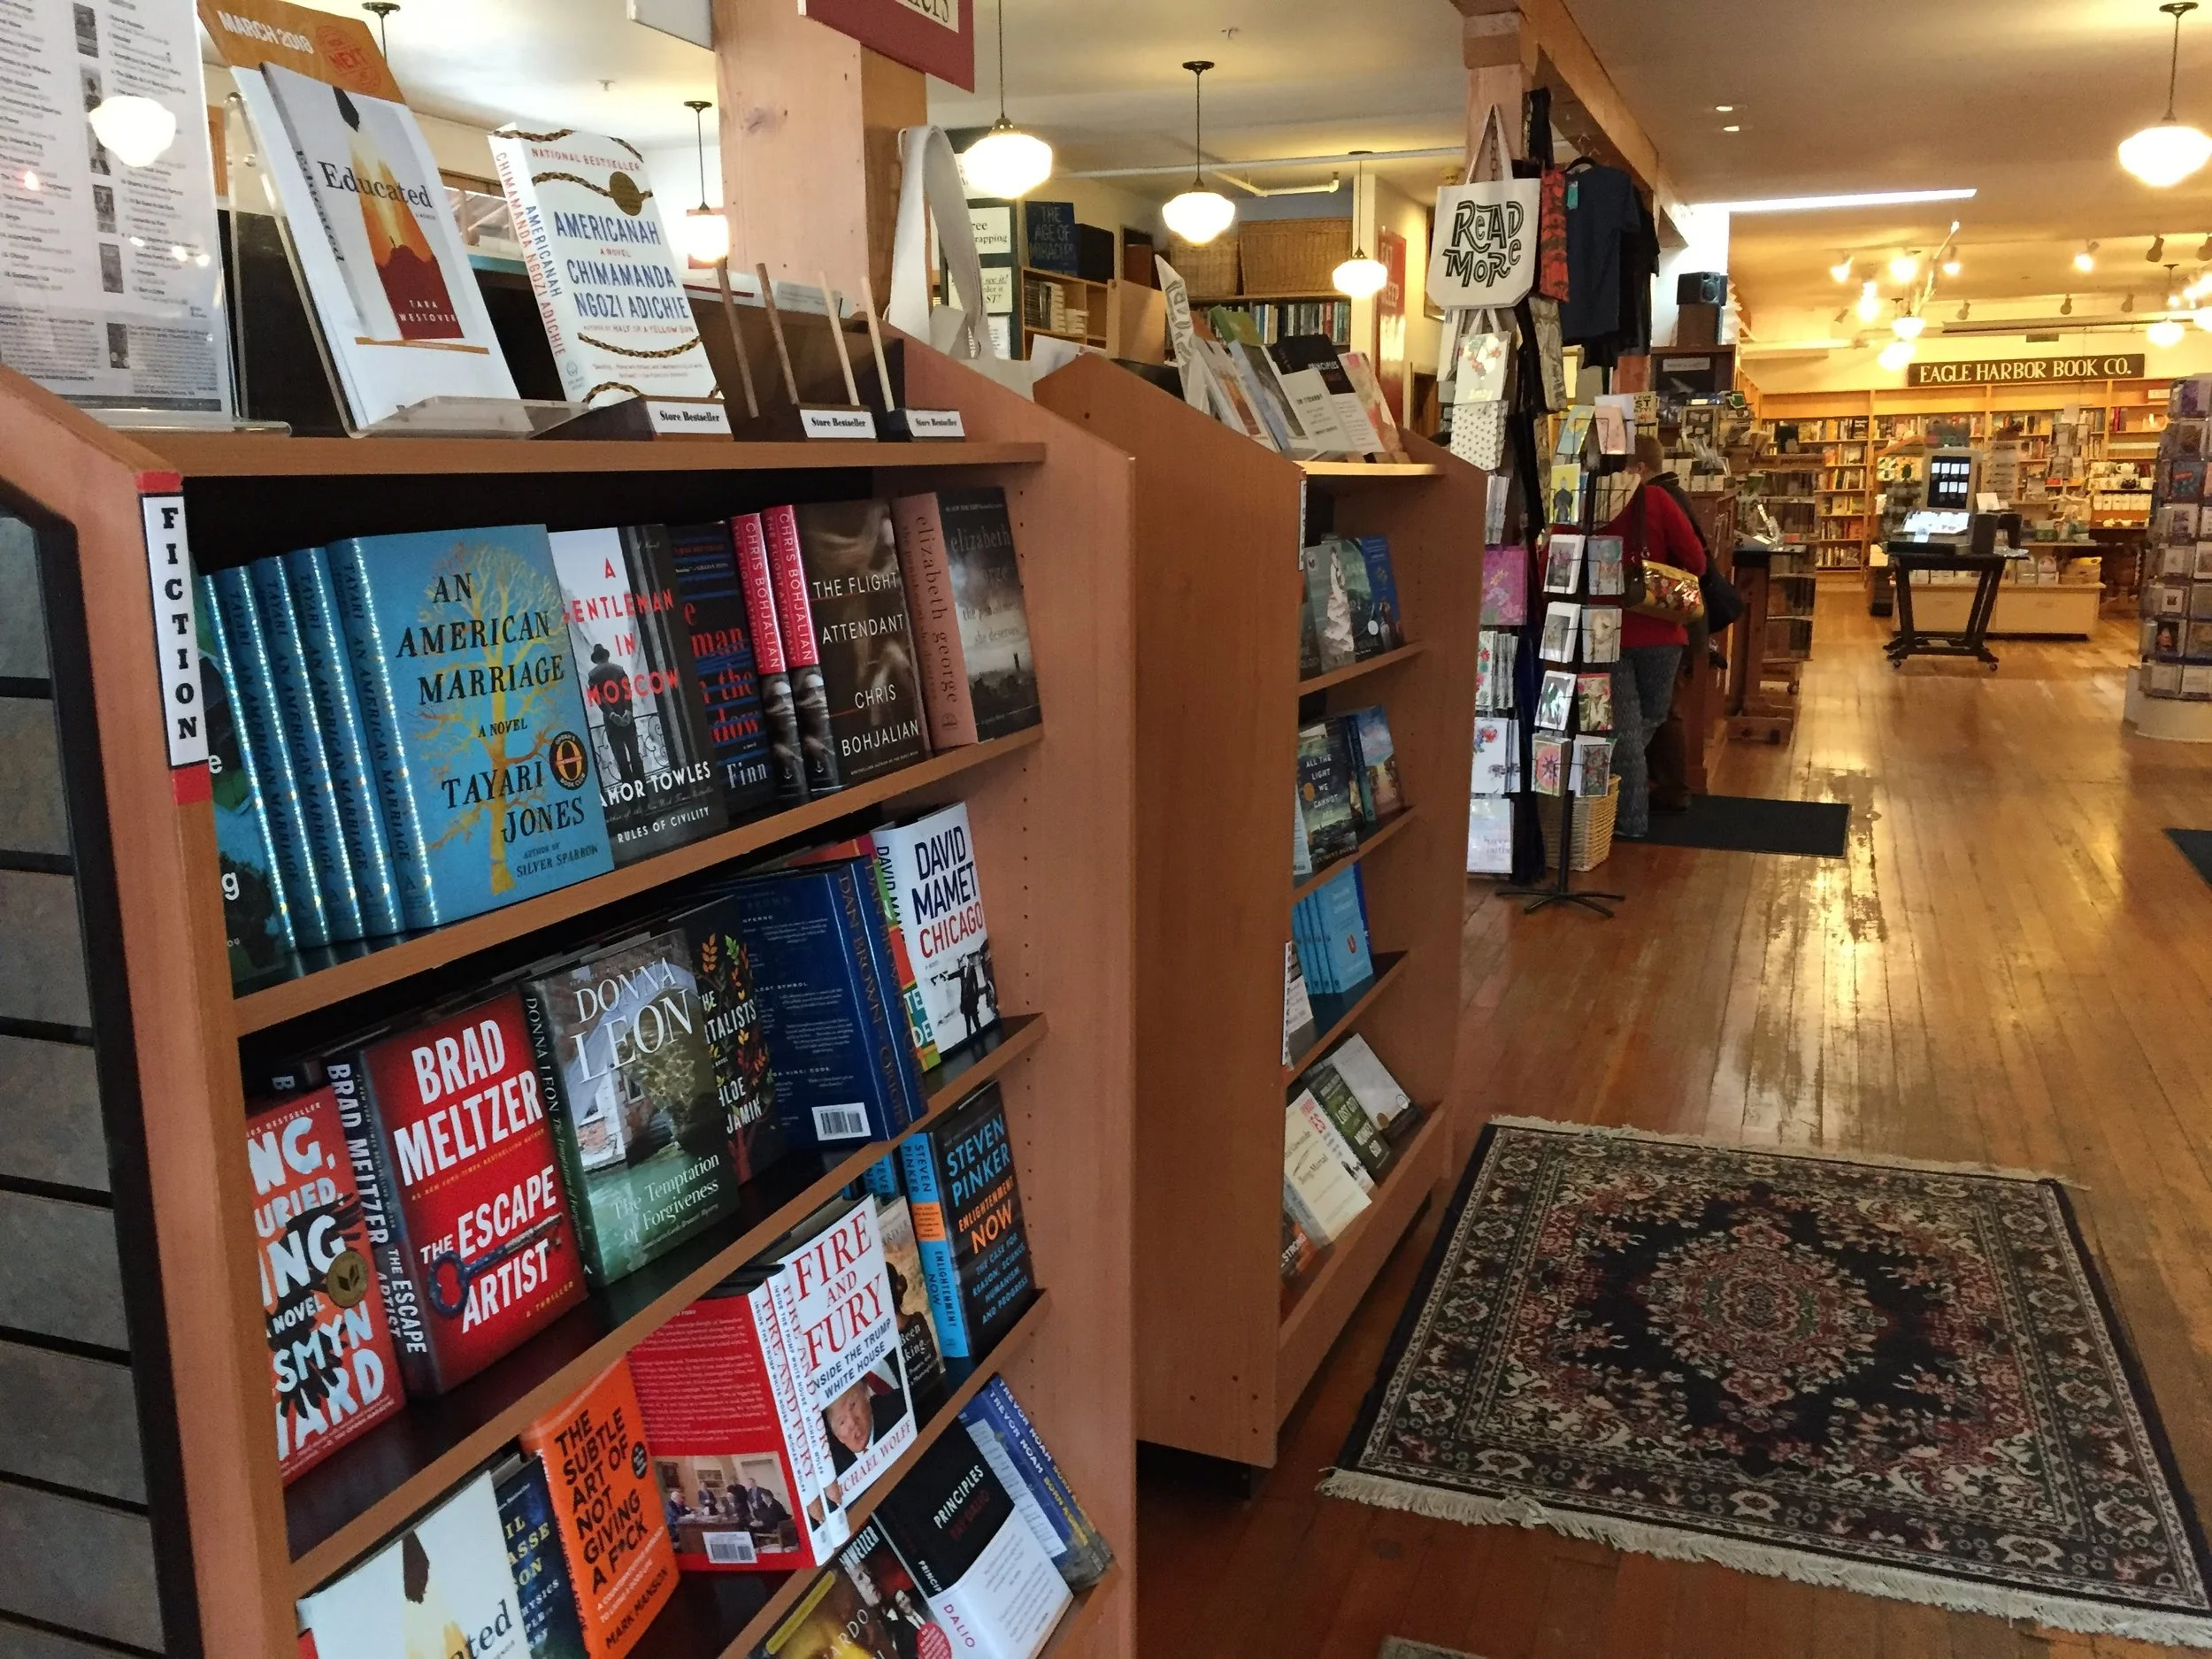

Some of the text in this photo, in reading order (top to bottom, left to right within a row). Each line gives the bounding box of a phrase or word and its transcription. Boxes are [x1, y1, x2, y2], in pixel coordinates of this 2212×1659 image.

[217, 10, 279, 44] MARCH
[317, 160, 433, 208] Educated
[531, 147, 641, 172] NATIONAL BESTSELLER
[526, 204, 564, 298] AMERICANAH
[553, 211, 662, 246] AMERICANAH
[974, 234, 1008, 243] rapping
[496, 152, 566, 356] CHIMAMANDA NGOZI ADICHIE
[565, 258, 678, 288] CHIMAMANDA
[398, 313, 457, 323] WESTOVER
[409, 299, 438, 310] TARA
[574, 292, 691, 320] NGOZI ADICHIE
[1920, 357, 2132, 383] EAGLE HARBOR BOOK CO.
[659, 410, 720, 423] Store Bestseller
[810, 418, 867, 429] Store Bestseller
[915, 419, 958, 428] Store Bestseller
[950, 524, 1011, 553] elizabeth
[432, 572, 474, 603] AN
[604, 557, 617, 580] A
[765, 517, 796, 662] THE FLIGHT ATTENDANT
[780, 513, 814, 660] CHRIS BOHJALIAN
[813, 572, 900, 600] THE FLIGHT
[745, 522, 780, 668] CHRIS BOHJALIAN
[917, 516, 957, 703] elizabeth george
[160, 507, 197, 739] FICTION
[395, 611, 550, 658] AMERICAN
[615, 634, 636, 658] IN
[822, 614, 905, 645] ATTENDANT
[418, 654, 566, 706] MARRIAGE
[586, 666, 680, 708] MOSCOW
[855, 684, 898, 710] CHRIS
[478, 718, 529, 739] A NOVEL
[841, 719, 921, 757] BOHJALIAN
[442, 761, 543, 809] TAYARI
[650, 760, 711, 793] TOWLES
[726, 763, 767, 790] Finn
[1305, 754, 1332, 768] ALL THE
[1311, 768, 1331, 780] LIGHT
[1318, 783, 1329, 792] WE
[382, 768, 411, 862] MARRIAGE
[501, 796, 585, 843] JONES
[618, 806, 710, 843] RULES OF CIVILITY
[517, 844, 598, 878] SILVER SPARROW
[914, 826, 968, 881] DAVID
[911, 861, 978, 926] MAMET
[840, 876, 882, 1024] DAN BROWN
[919, 901, 984, 959] CHICAGO
[574, 957, 678, 1025] DONNA
[526, 997, 561, 1113] DONNA LEON
[571, 988, 695, 1085] LEON
[411, 1018, 507, 1106] BRAD
[393, 1069, 545, 1187] MELTZER
[946, 1114, 1006, 1178] STEVEN
[327, 1063, 362, 1129] BRAD
[347, 1138, 390, 1245] MELTZER
[904, 1146, 920, 1194] PINKER
[915, 1144, 933, 1193] STEVEN
[950, 1142, 1010, 1209] PINKER
[457, 1164, 557, 1259] ESCAPE
[611, 1154, 720, 1221] The Temptation
[624, 1225, 641, 1243] of
[642, 1179, 719, 1232] Forgiveness
[958, 1175, 1015, 1233] ENLIGHTENMENT
[419, 1233, 454, 1265] THE
[971, 1199, 1014, 1254] NOW
[792, 1210, 876, 1302] FIRE
[976, 1245, 1006, 1276] THE CASE
[387, 1248, 428, 1354] THE ESCAPE
[462, 1238, 549, 1334] ARTIST
[535, 1280, 575, 1311] THRILLER
[826, 1271, 857, 1310] AND
[928, 1274, 941, 1306] NOW
[934, 1250, 957, 1328] ENLIGHTENMENT
[981, 1277, 1030, 1325] AND PROGRESS
[273, 1293, 326, 1336] NOVEL
[803, 1274, 883, 1371] FURY
[754, 1302, 764, 1329] INSIDE
[765, 1345, 775, 1371] TRUMP
[779, 1398, 789, 1425] HOUSE
[843, 1317, 893, 1368] THE TRUMP
[762, 1301, 816, 1479] FIRE AND FURY
[773, 1285, 783, 1310] INSIDE
[784, 1326, 795, 1354] TRUMP
[797, 1381, 808, 1407] HOUSE
[805, 1416, 818, 1451] MICHAEL
[783, 1284, 832, 1461] FIRE AND FURY
[824, 1340, 887, 1400] WHITE HOUSE
[554, 1409, 594, 1459] THE
[882, 1418, 912, 1466] WOLFF
[999, 1379, 1053, 1463] TREVOR NOAH
[563, 1406, 626, 1486] SUBTLE
[989, 1390, 1065, 1506] TREVOR NOAH BORN
[572, 1432, 630, 1515] ART OF
[933, 1463, 986, 1531] PRINCIPLES
[575, 1484, 612, 1541] NOT
[582, 1488, 642, 1566] GIVING
[590, 1565, 609, 1595] A
[605, 1613, 634, 1650] MARK
[943, 1603, 977, 1648] DALIO
